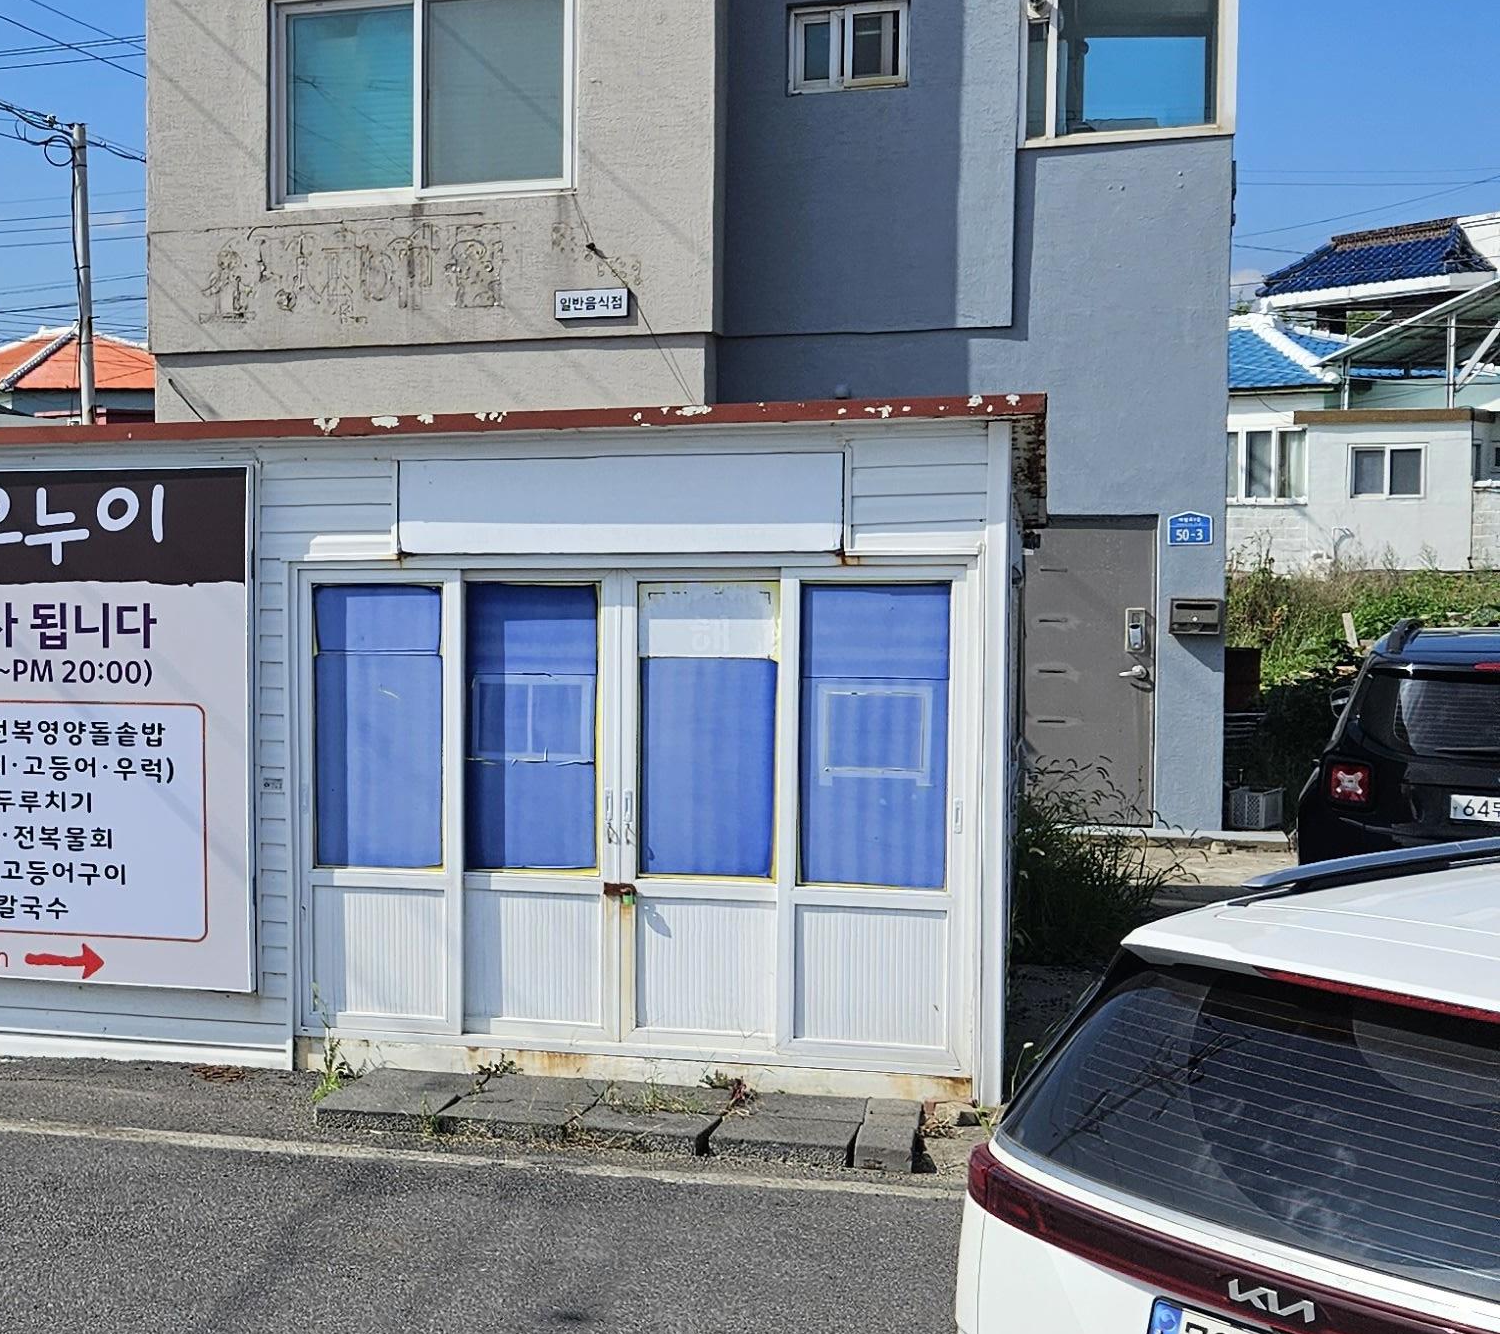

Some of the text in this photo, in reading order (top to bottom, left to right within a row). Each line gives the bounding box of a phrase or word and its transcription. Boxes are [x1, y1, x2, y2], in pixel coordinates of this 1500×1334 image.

[560, 295, 623, 312] 일반음식점
[1176, 528, 1203, 541] 50-3
[30, 602, 158, 650] 됩니다
[61, 659, 152, 687] 20:00)
[1228, 1278, 1316, 1323] KIA
